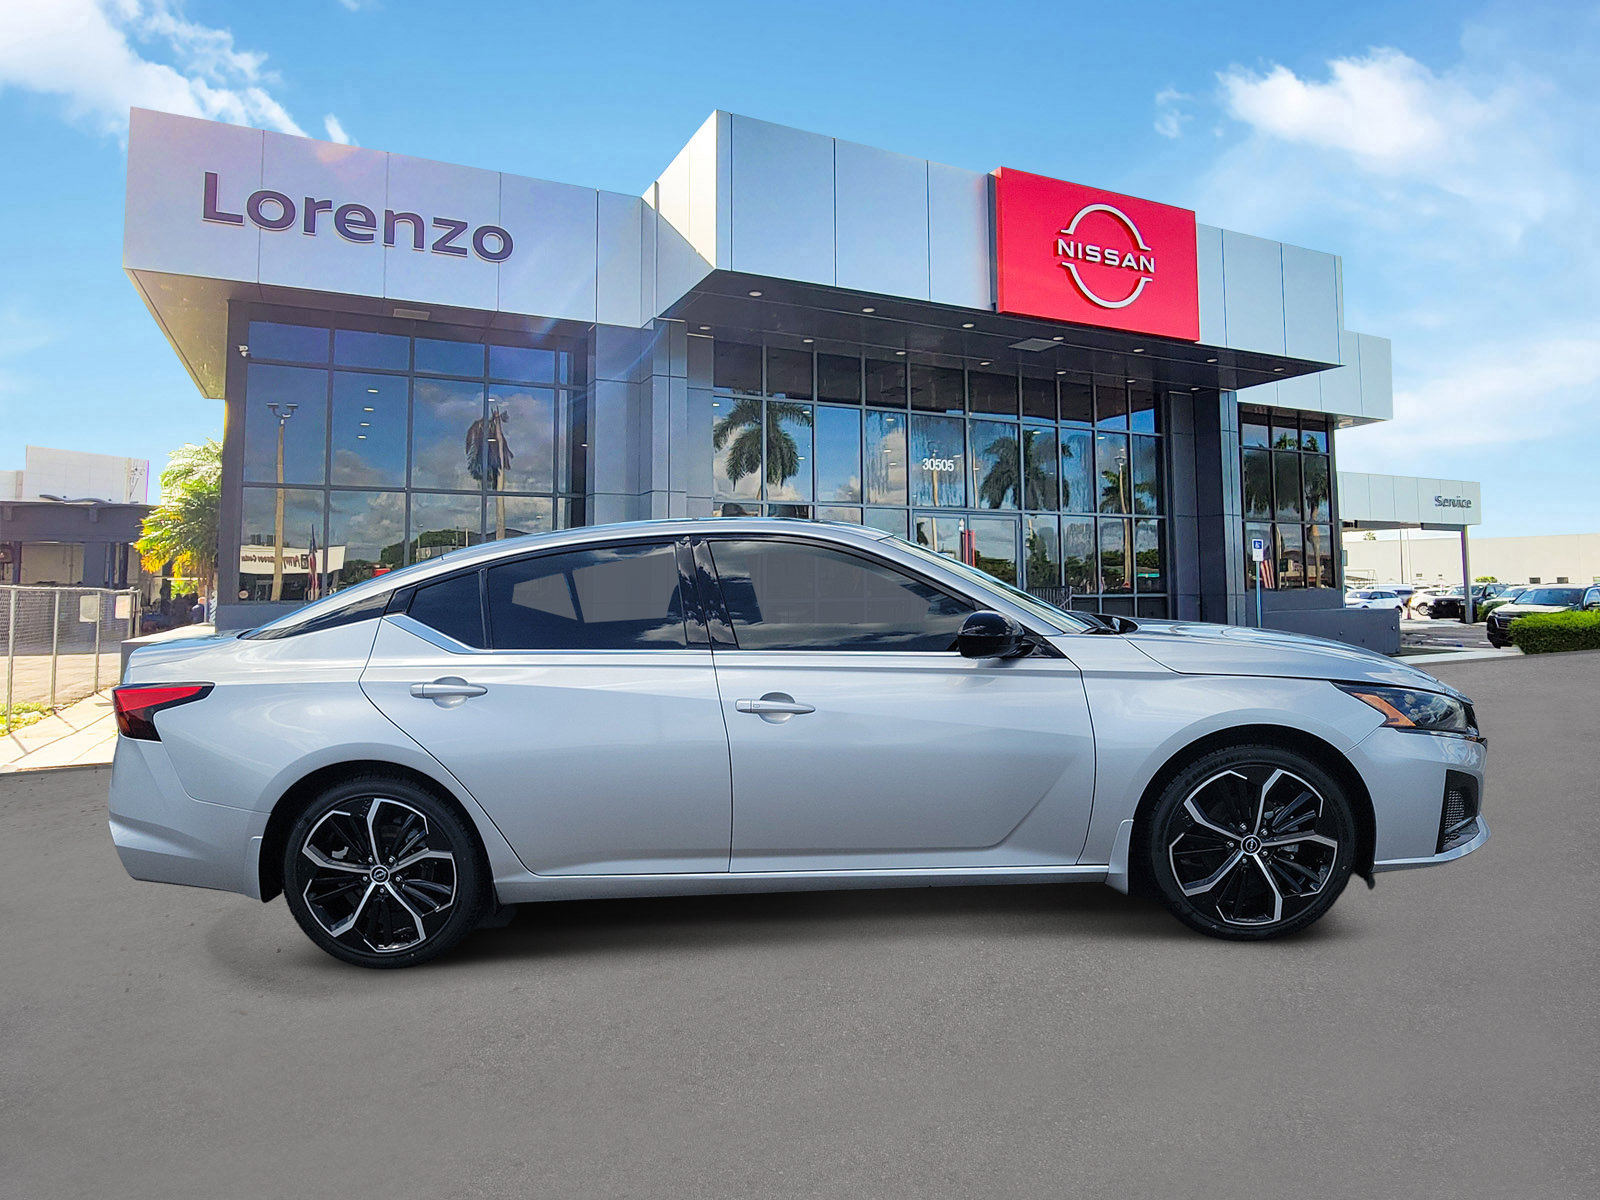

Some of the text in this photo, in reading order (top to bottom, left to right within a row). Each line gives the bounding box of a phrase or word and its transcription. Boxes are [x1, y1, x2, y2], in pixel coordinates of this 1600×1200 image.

[202, 171, 514, 262] Lorenzo
[1057, 238, 1155, 273] NISSAN
[922, 458, 955, 472] 30505
[1434, 495, 1472, 509] Service
